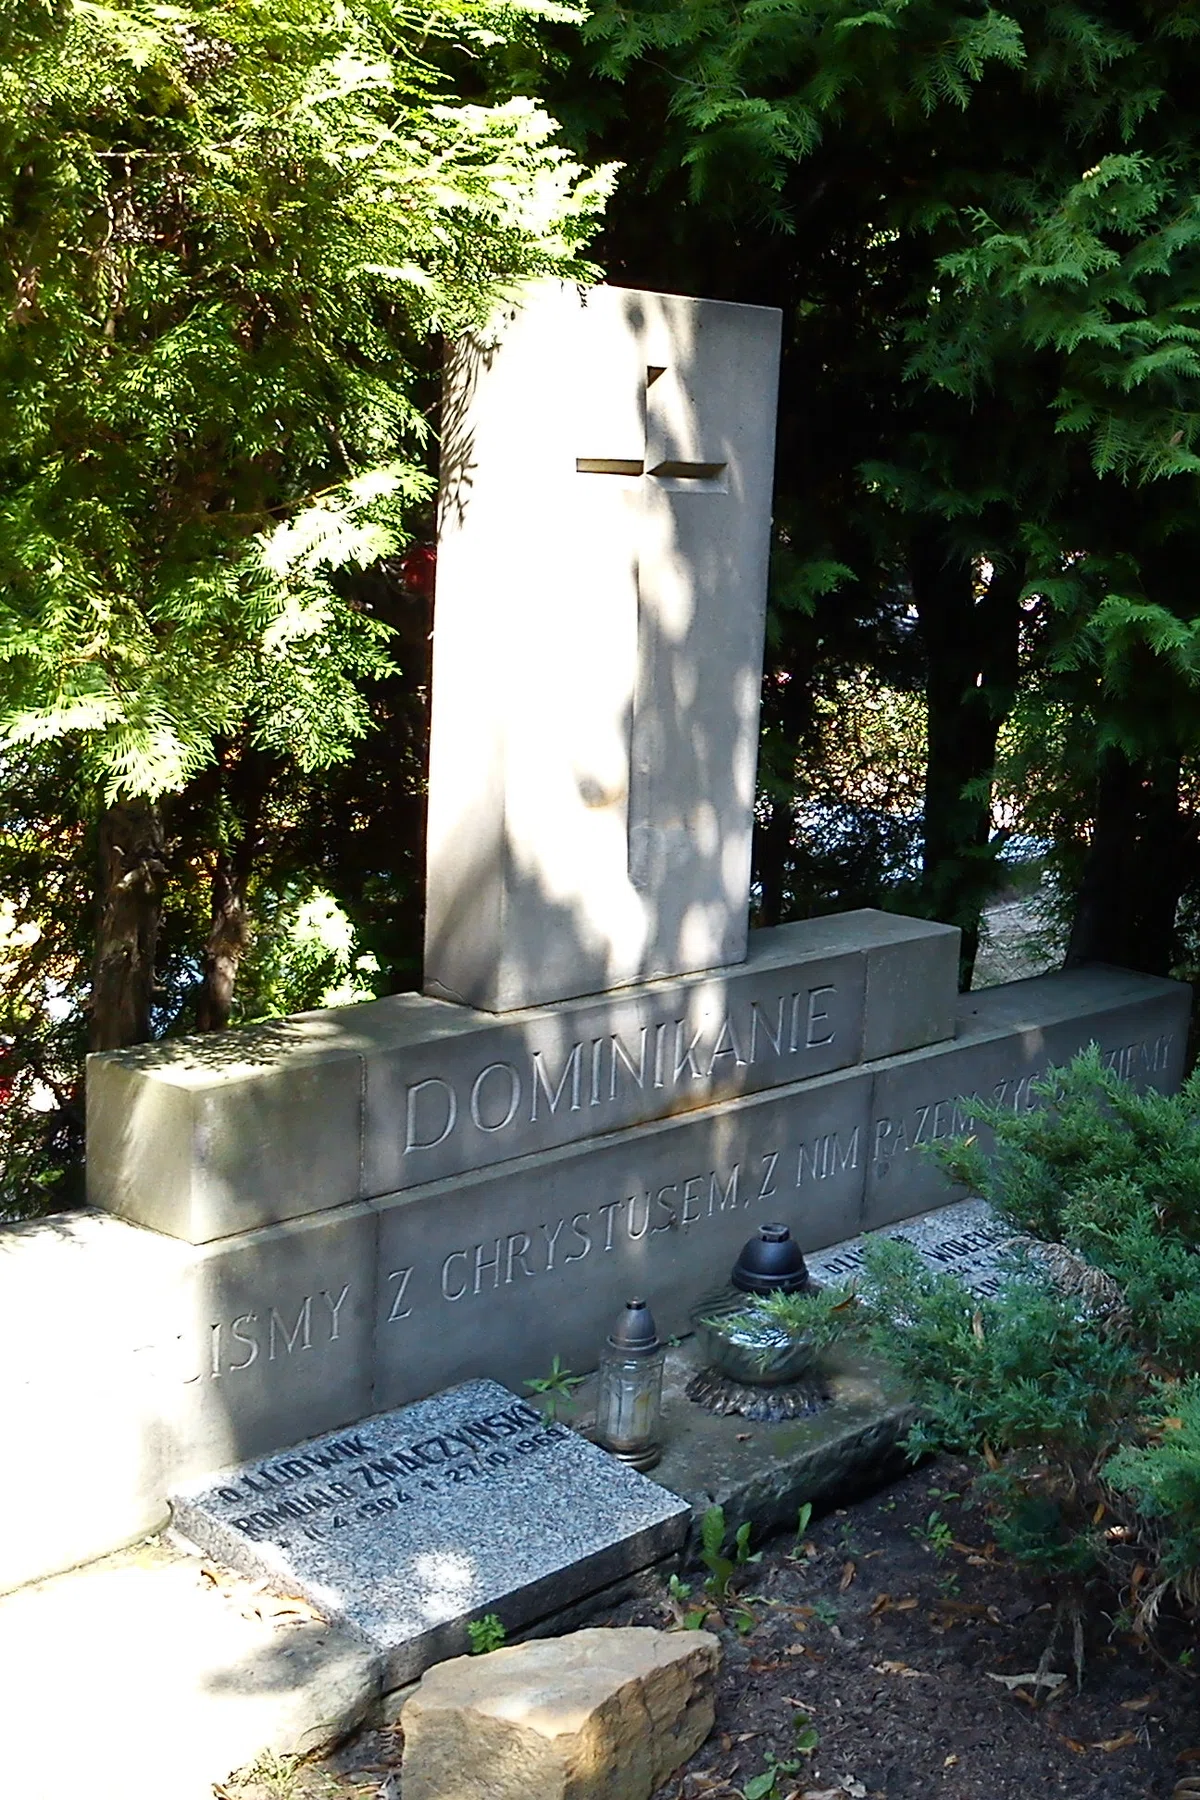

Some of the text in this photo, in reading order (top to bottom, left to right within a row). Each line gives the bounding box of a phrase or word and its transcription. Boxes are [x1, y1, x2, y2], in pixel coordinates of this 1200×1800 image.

[403, 983, 837, 1155] DOMINIKANIE
[387, 1265, 414, 1323] Z
[441, 1163, 750, 1302] CHRYSTUSEM,
[757, 1151, 779, 1200] Z
[796, 1126, 861, 1187] NIM
[872, 1090, 977, 1161] RAZEM
[230, 1481, 358, 1543] ROMUALD
[240, 1435, 377, 1492] LUDWIK
